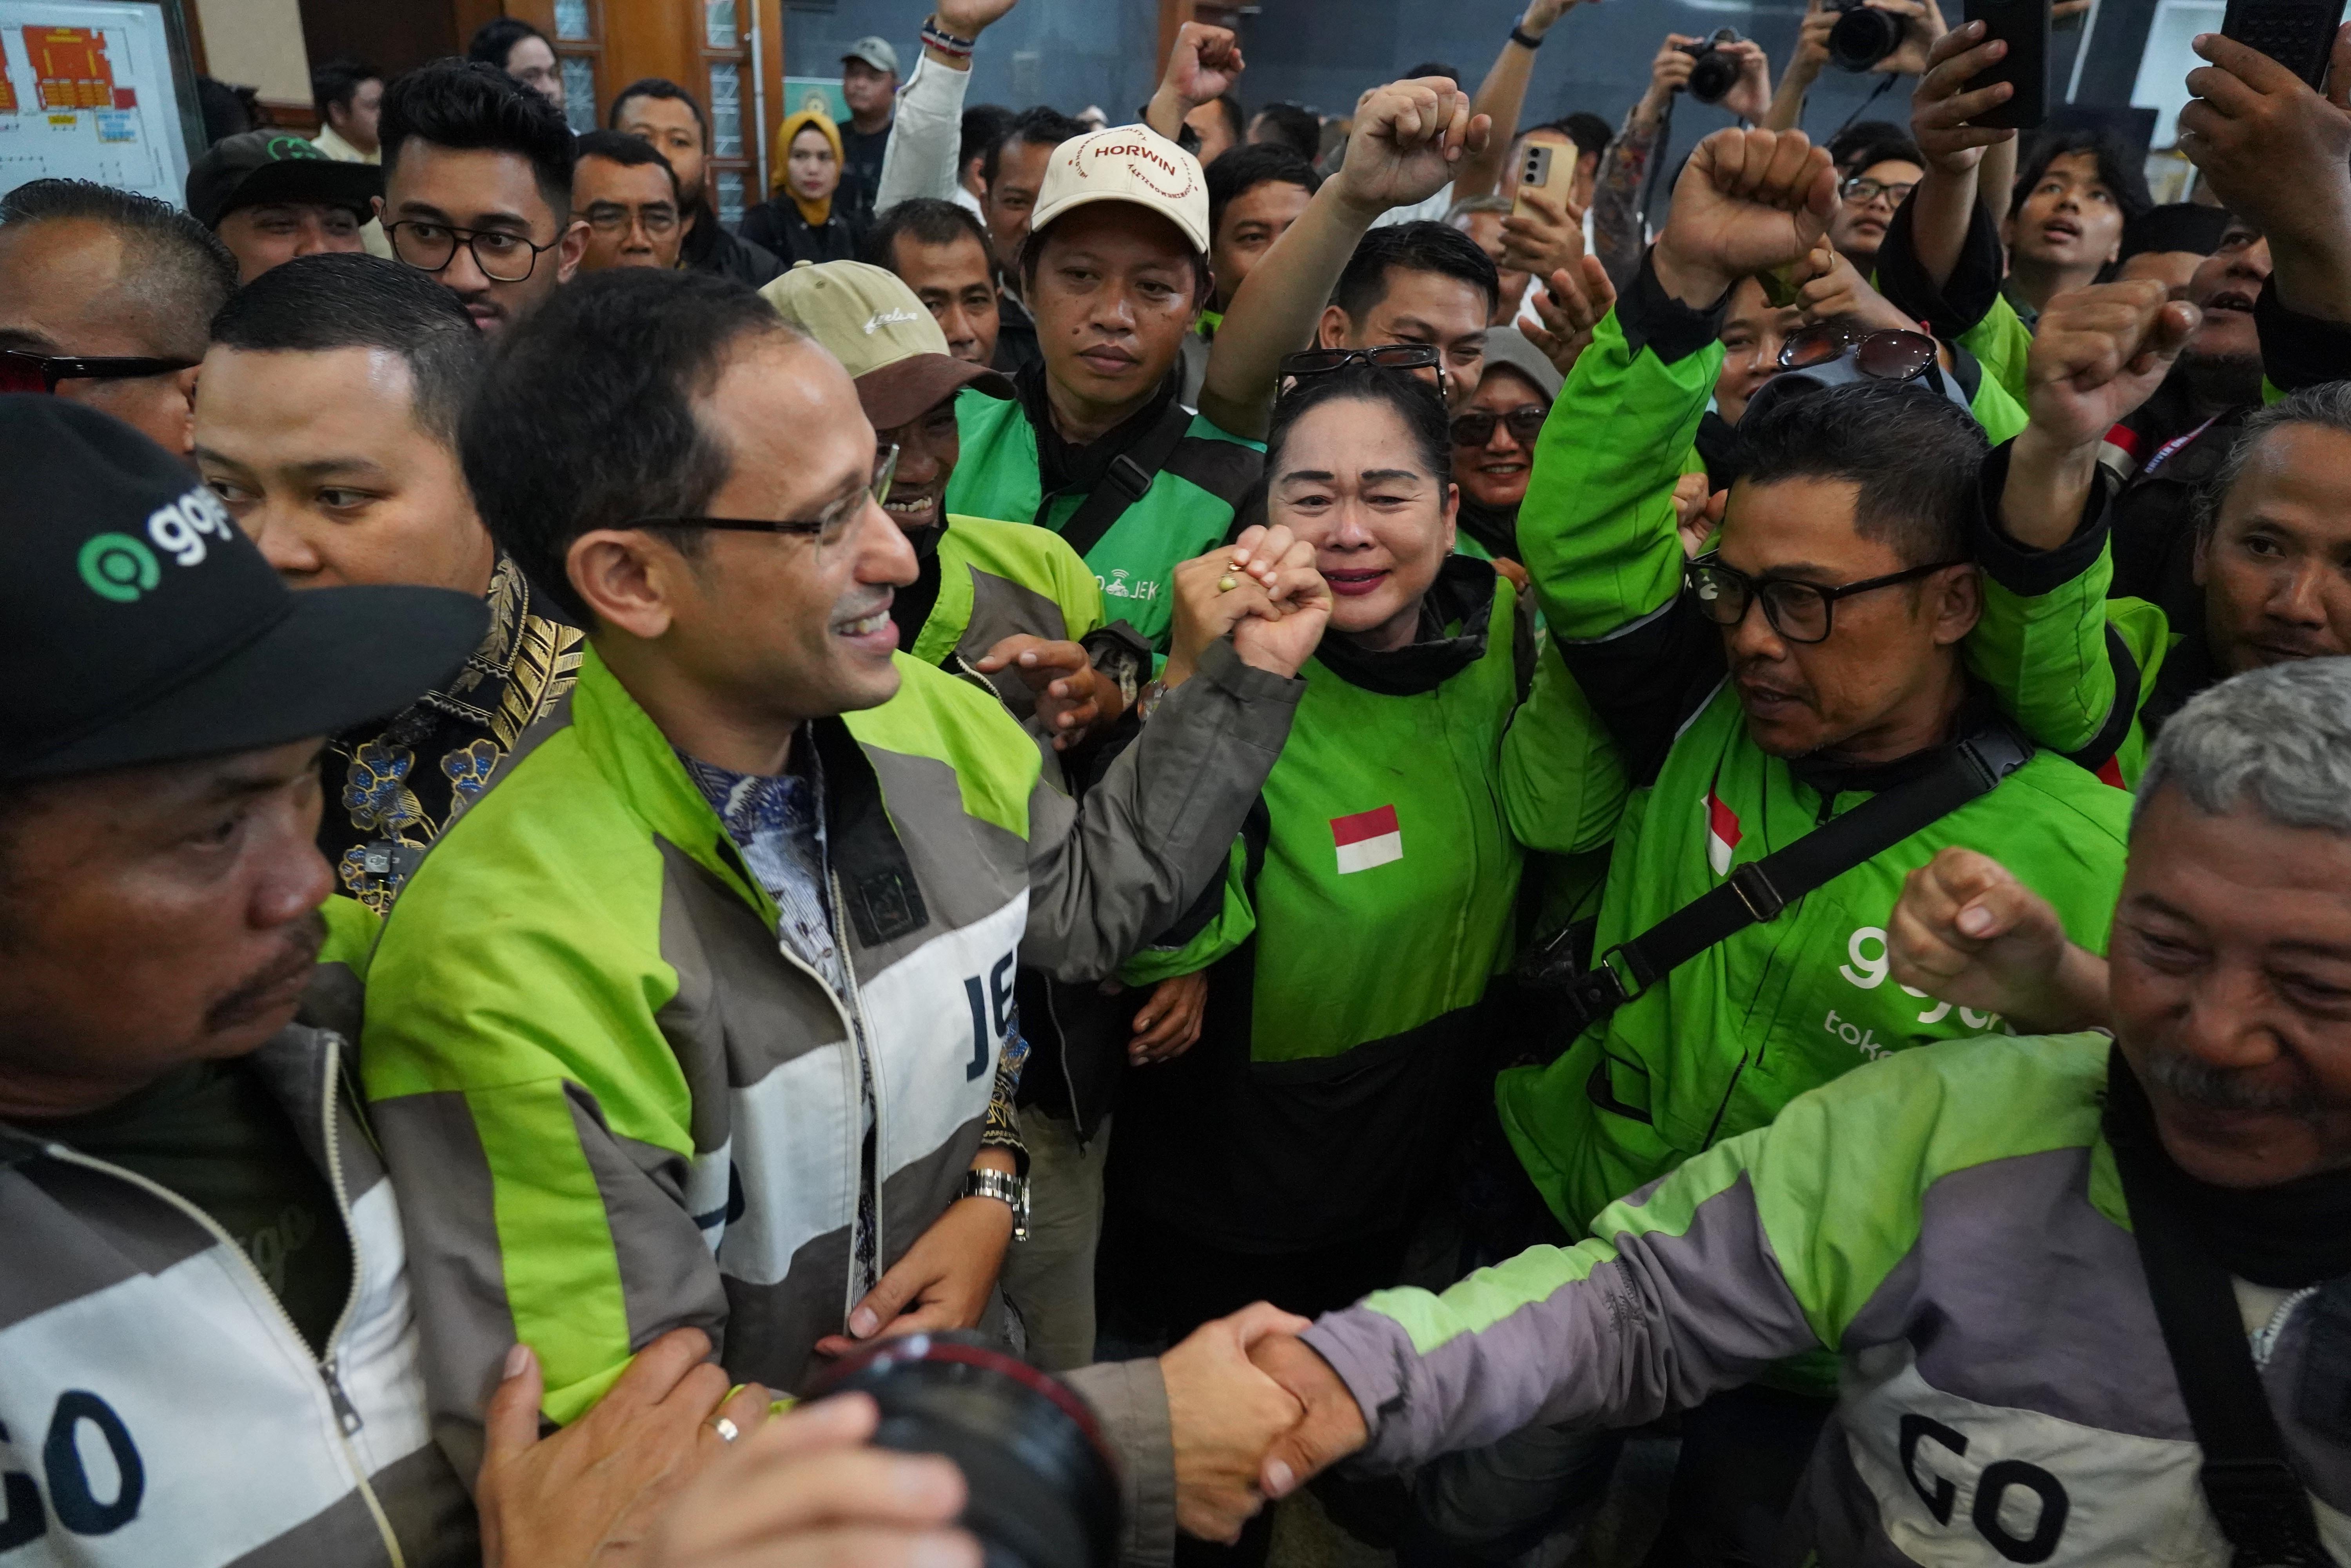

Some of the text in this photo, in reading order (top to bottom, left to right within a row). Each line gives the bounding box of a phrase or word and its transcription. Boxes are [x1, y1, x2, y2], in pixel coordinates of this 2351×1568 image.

[1095, 145, 1175, 176] HORWIN
[1130, 581, 1160, 600] JEK
[1900, 1414, 2070, 1564] GO
